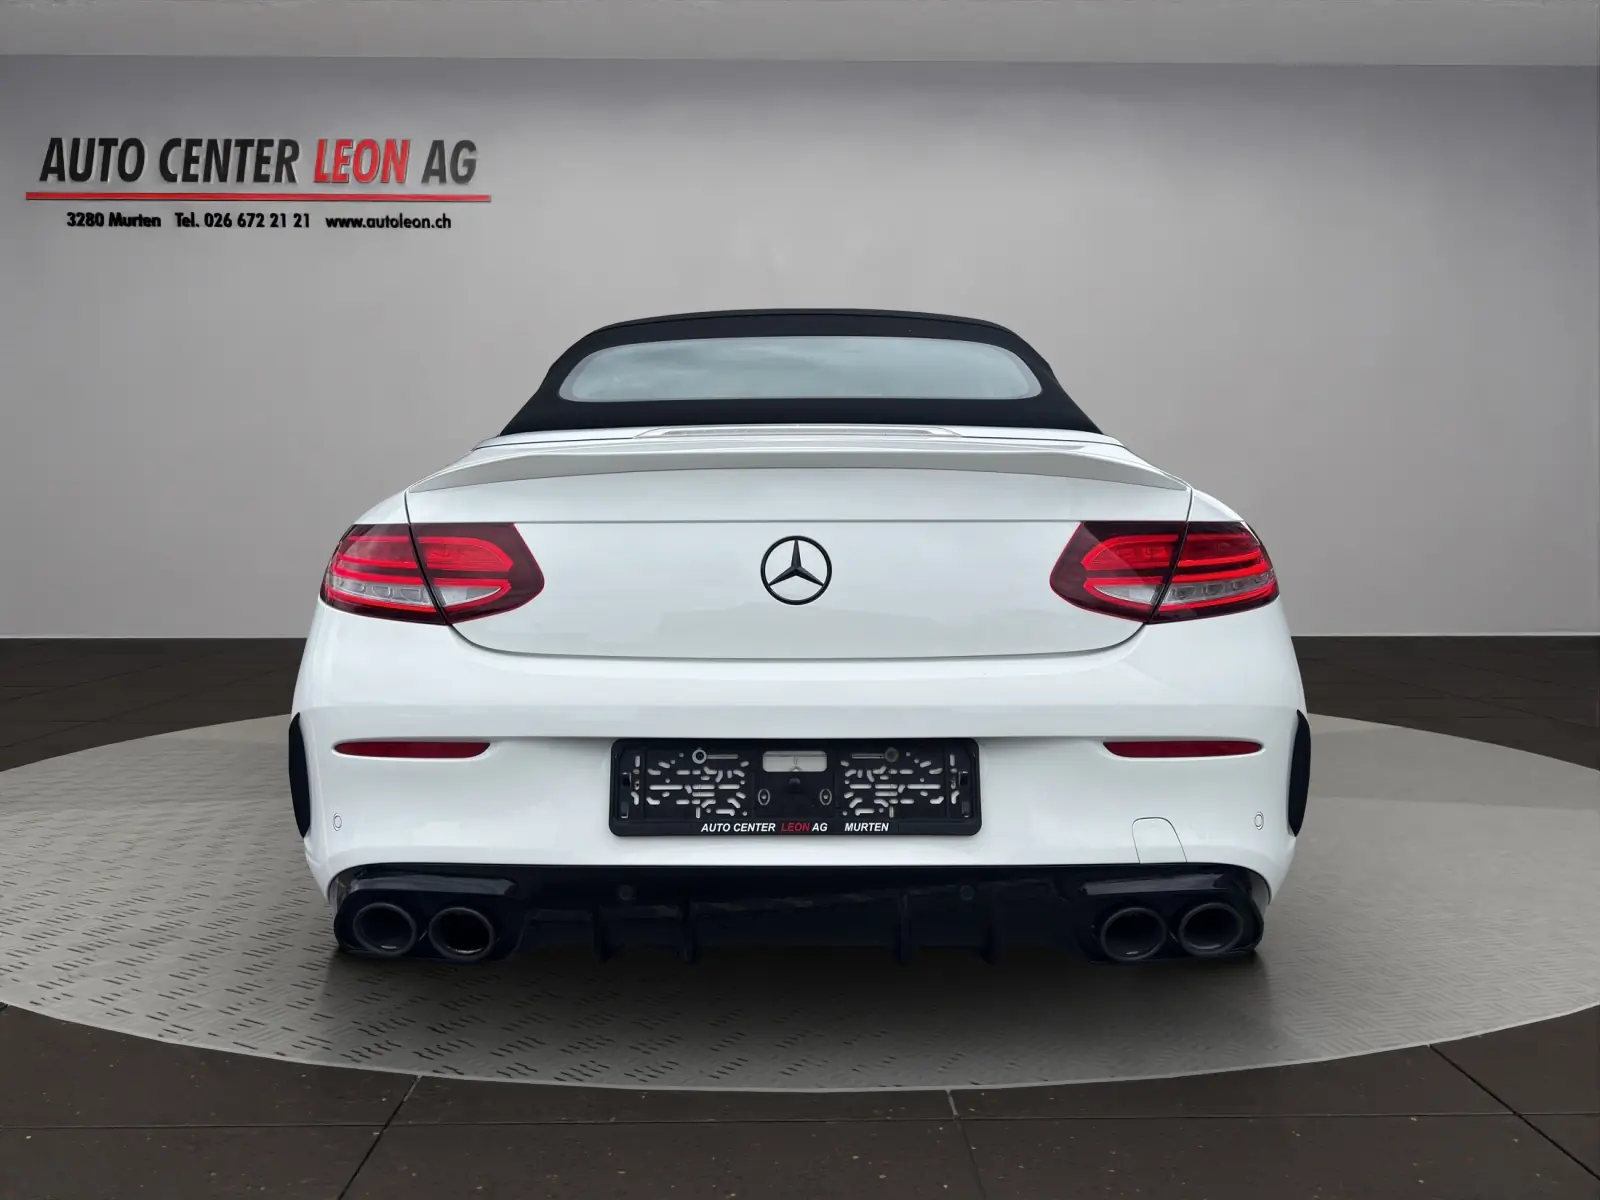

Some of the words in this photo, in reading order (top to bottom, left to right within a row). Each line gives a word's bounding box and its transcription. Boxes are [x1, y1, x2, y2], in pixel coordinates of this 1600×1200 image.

[40, 137, 145, 183] AUTO
[159, 138, 300, 184] CENTER
[313, 138, 411, 184] LEON
[421, 139, 478, 185] AG
[66, 212, 105, 228] 3280
[108, 213, 162, 228] Murten
[175, 213, 200, 228] Tel.
[204, 213, 233, 228] 026
[236, 213, 265, 228] 672
[269, 213, 288, 228] 21
[293, 213, 311, 228] 21
[325, 213, 452, 229] www.autoleon.ch
[701, 823, 732, 833] AUTO
[733, 822, 776, 833] CENTER
[781, 822, 810, 833] LEON
[812, 822, 828, 833] AG
[845, 822, 889, 833] MURTEN
